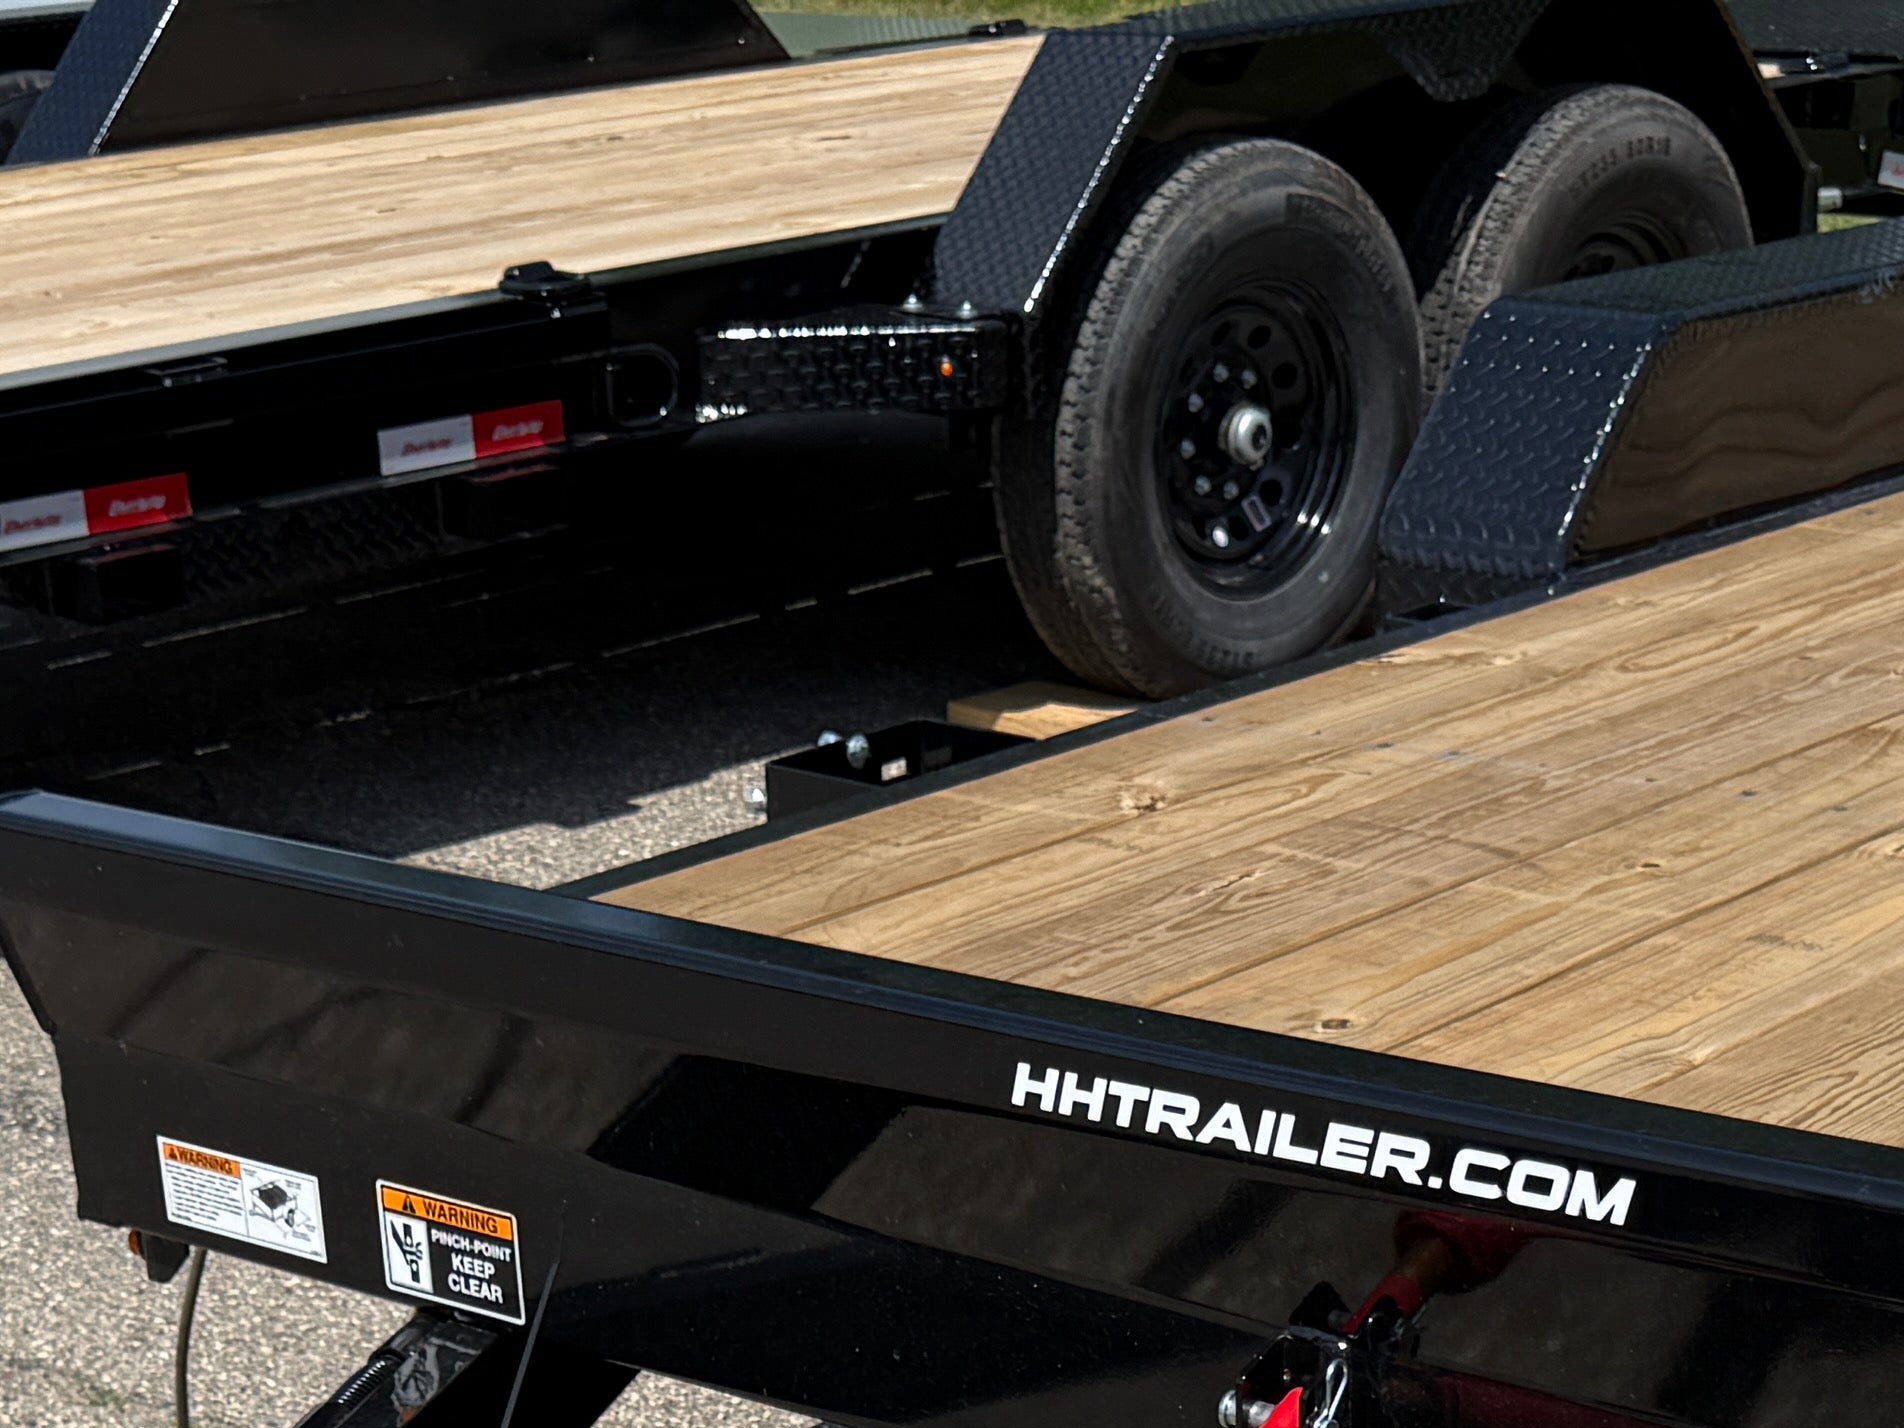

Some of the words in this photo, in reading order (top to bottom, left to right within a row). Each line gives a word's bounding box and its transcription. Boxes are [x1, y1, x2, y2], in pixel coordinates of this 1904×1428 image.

[1010, 1061, 1636, 1226] HHTRAILER.COM
[176, 1148, 232, 1174] WARNING
[423, 1200, 498, 1234] WARNING
[430, 1228, 512, 1263] PINCH-POINT
[451, 1252, 496, 1281] KEEP
[447, 1272, 503, 1304] CLEAR
